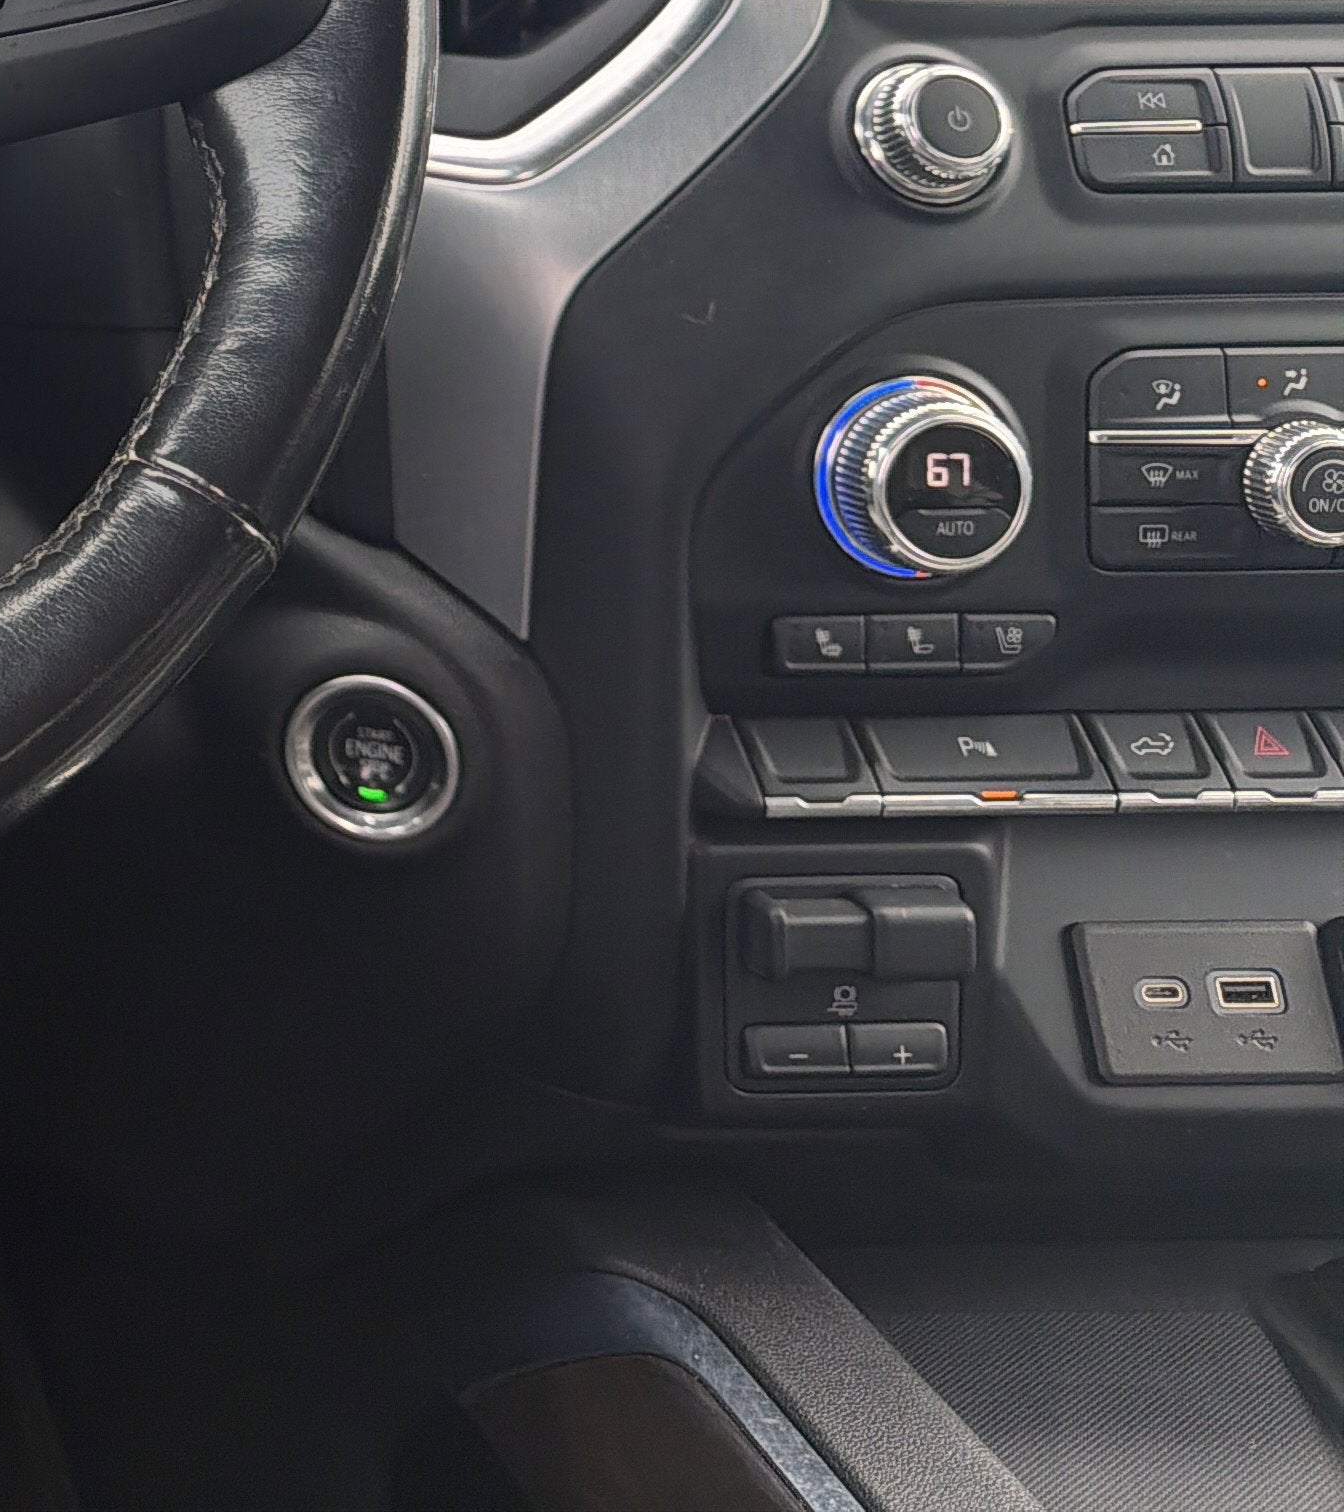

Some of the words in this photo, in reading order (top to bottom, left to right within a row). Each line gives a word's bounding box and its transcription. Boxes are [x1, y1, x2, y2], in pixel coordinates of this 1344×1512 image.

[926, 452, 971, 487] 67
[1175, 469, 1199, 481] MAX
[935, 520, 975, 537] AUTO
[1170, 531, 1197, 542] REAR
